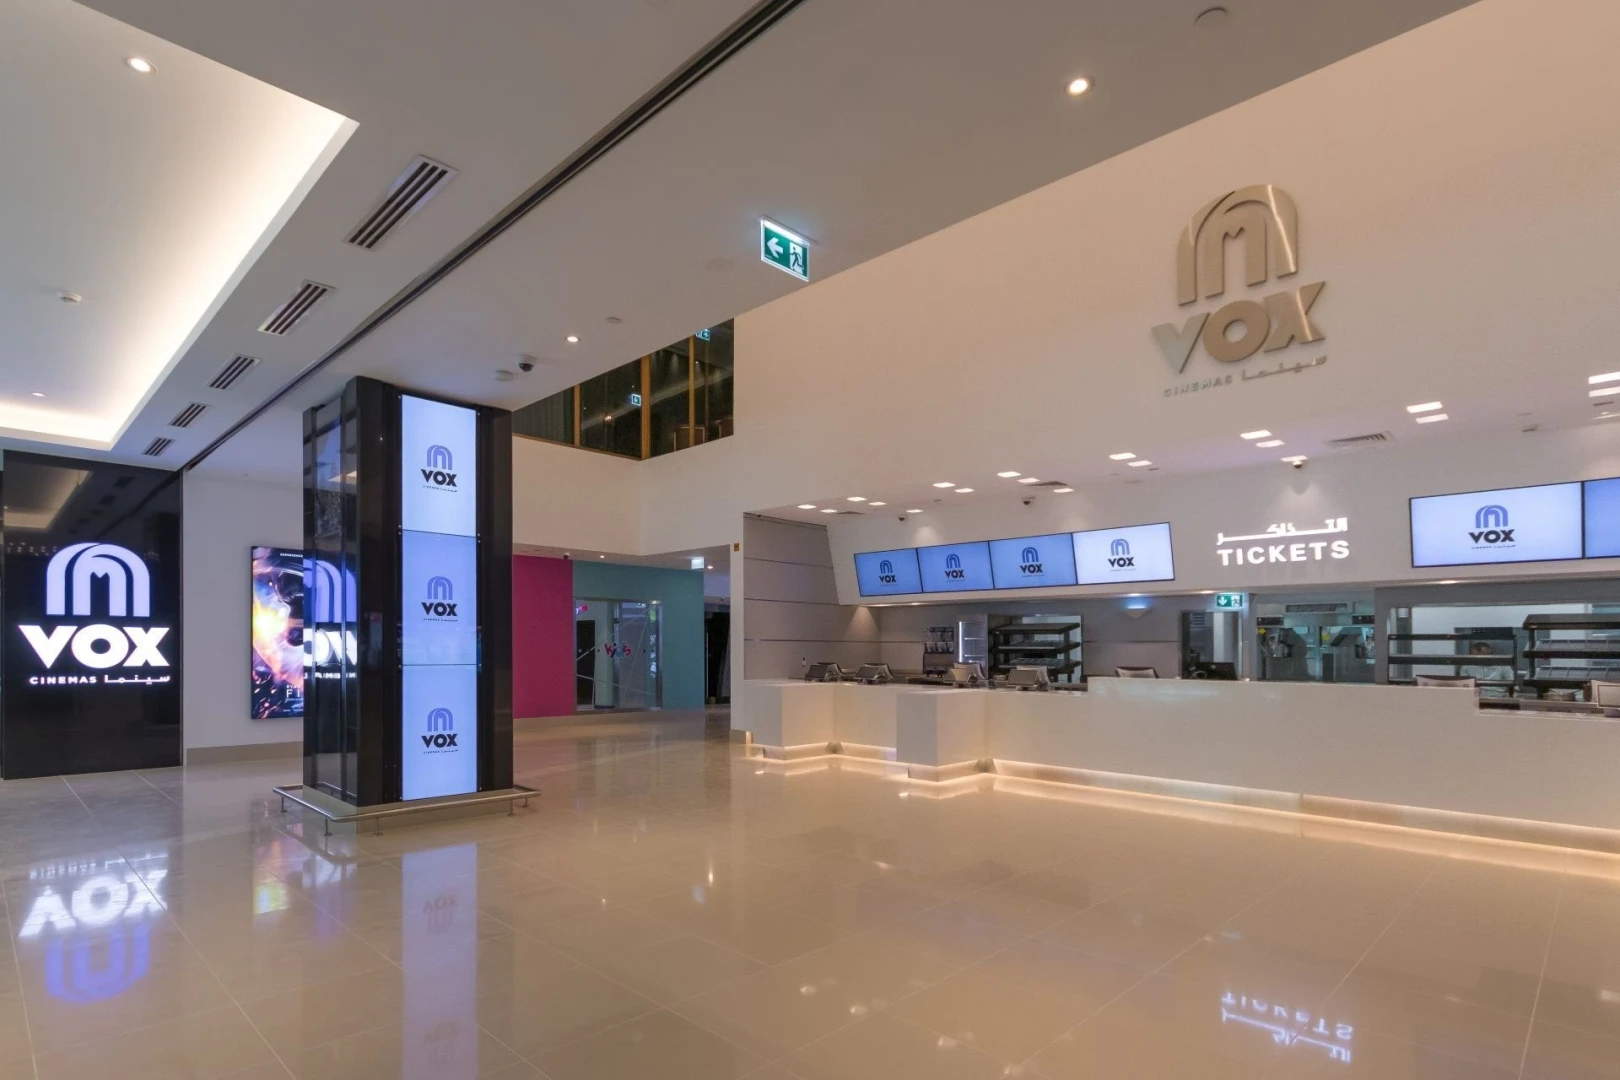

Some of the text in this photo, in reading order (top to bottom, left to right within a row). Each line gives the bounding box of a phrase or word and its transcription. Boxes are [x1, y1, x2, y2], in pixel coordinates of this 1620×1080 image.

[1151, 281, 1327, 375] VOX
[1163, 374, 1233, 397] CINEMAS
[420, 468, 458, 488] VOX
[1216, 517, 1348, 546] التذاكر
[1468, 529, 1516, 544] VOX
[1216, 540, 1350, 566] TICKETS
[1020, 563, 1043, 574] VOX
[1107, 557, 1135, 568] VOX
[879, 574, 897, 584] VOX
[944, 569, 965, 579] VOX
[421, 602, 458, 617] VOX
[18, 624, 170, 669] VOX
[29, 674, 170, 685] CINEMAS سينما
[421, 733, 458, 748] VOX
